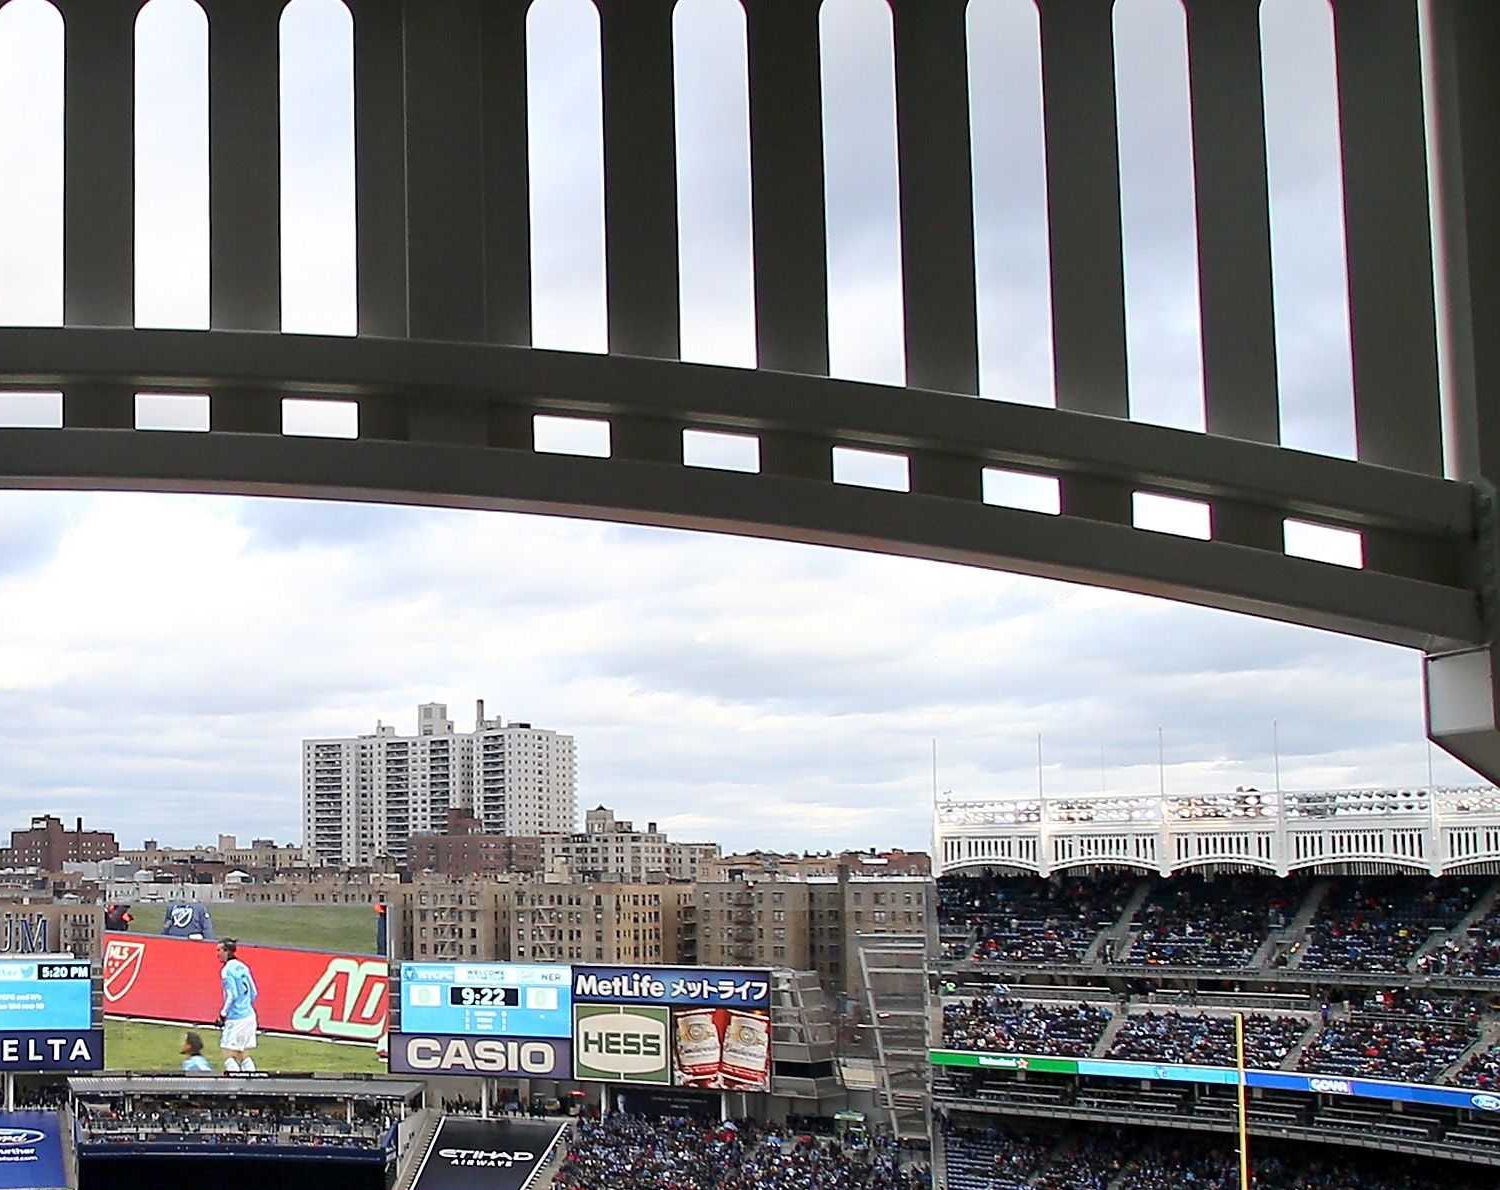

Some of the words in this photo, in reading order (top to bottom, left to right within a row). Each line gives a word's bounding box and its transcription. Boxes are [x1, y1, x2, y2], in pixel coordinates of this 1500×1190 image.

[109, 946, 130, 960] MLS
[42, 966, 68, 978] 5:20
[71, 966, 89, 978] PM
[576, 972, 665, 998] MetLife
[670, 978, 768, 1001] メットライフ
[461, 987, 506, 1006] 9:22
[583, 1031, 661, 1056] HESS
[406, 1038, 556, 1074] CASIO
[1310, 1077, 1349, 1094] GOYA
[438, 1148, 535, 1162] ETIHAD
[450, 1159, 514, 1168] AIRWAYS
